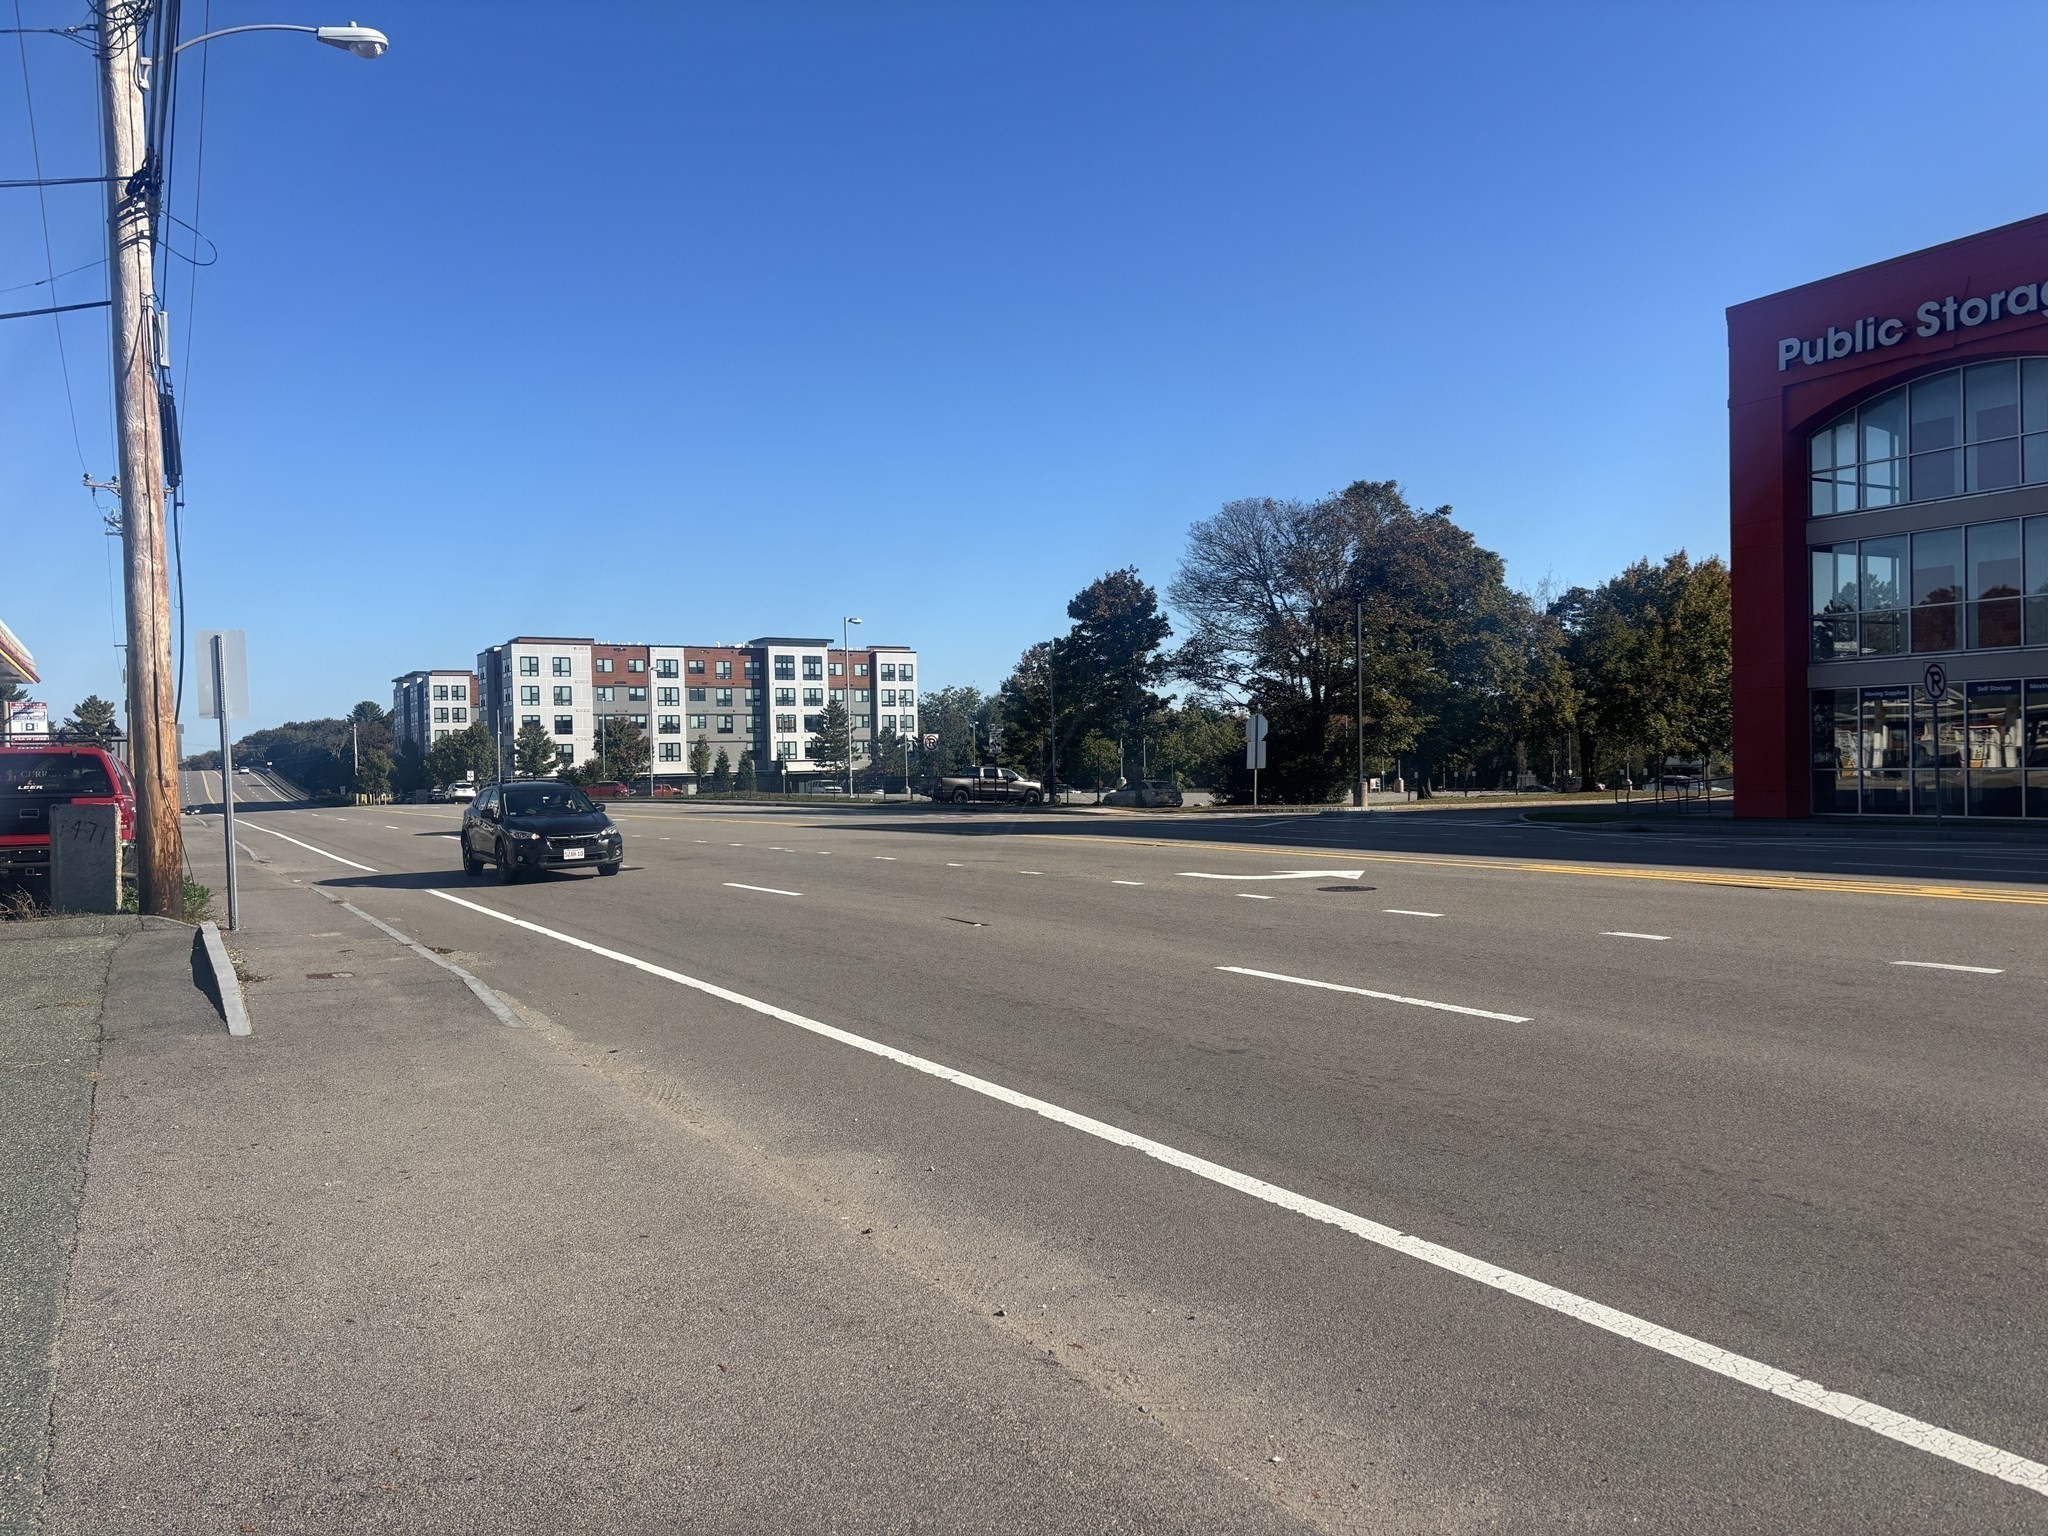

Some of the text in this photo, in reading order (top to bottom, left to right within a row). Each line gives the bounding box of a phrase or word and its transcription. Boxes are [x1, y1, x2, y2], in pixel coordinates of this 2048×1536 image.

[1778, 280, 2048, 372] Public Stora
[71, 820, 108, 846] 471
